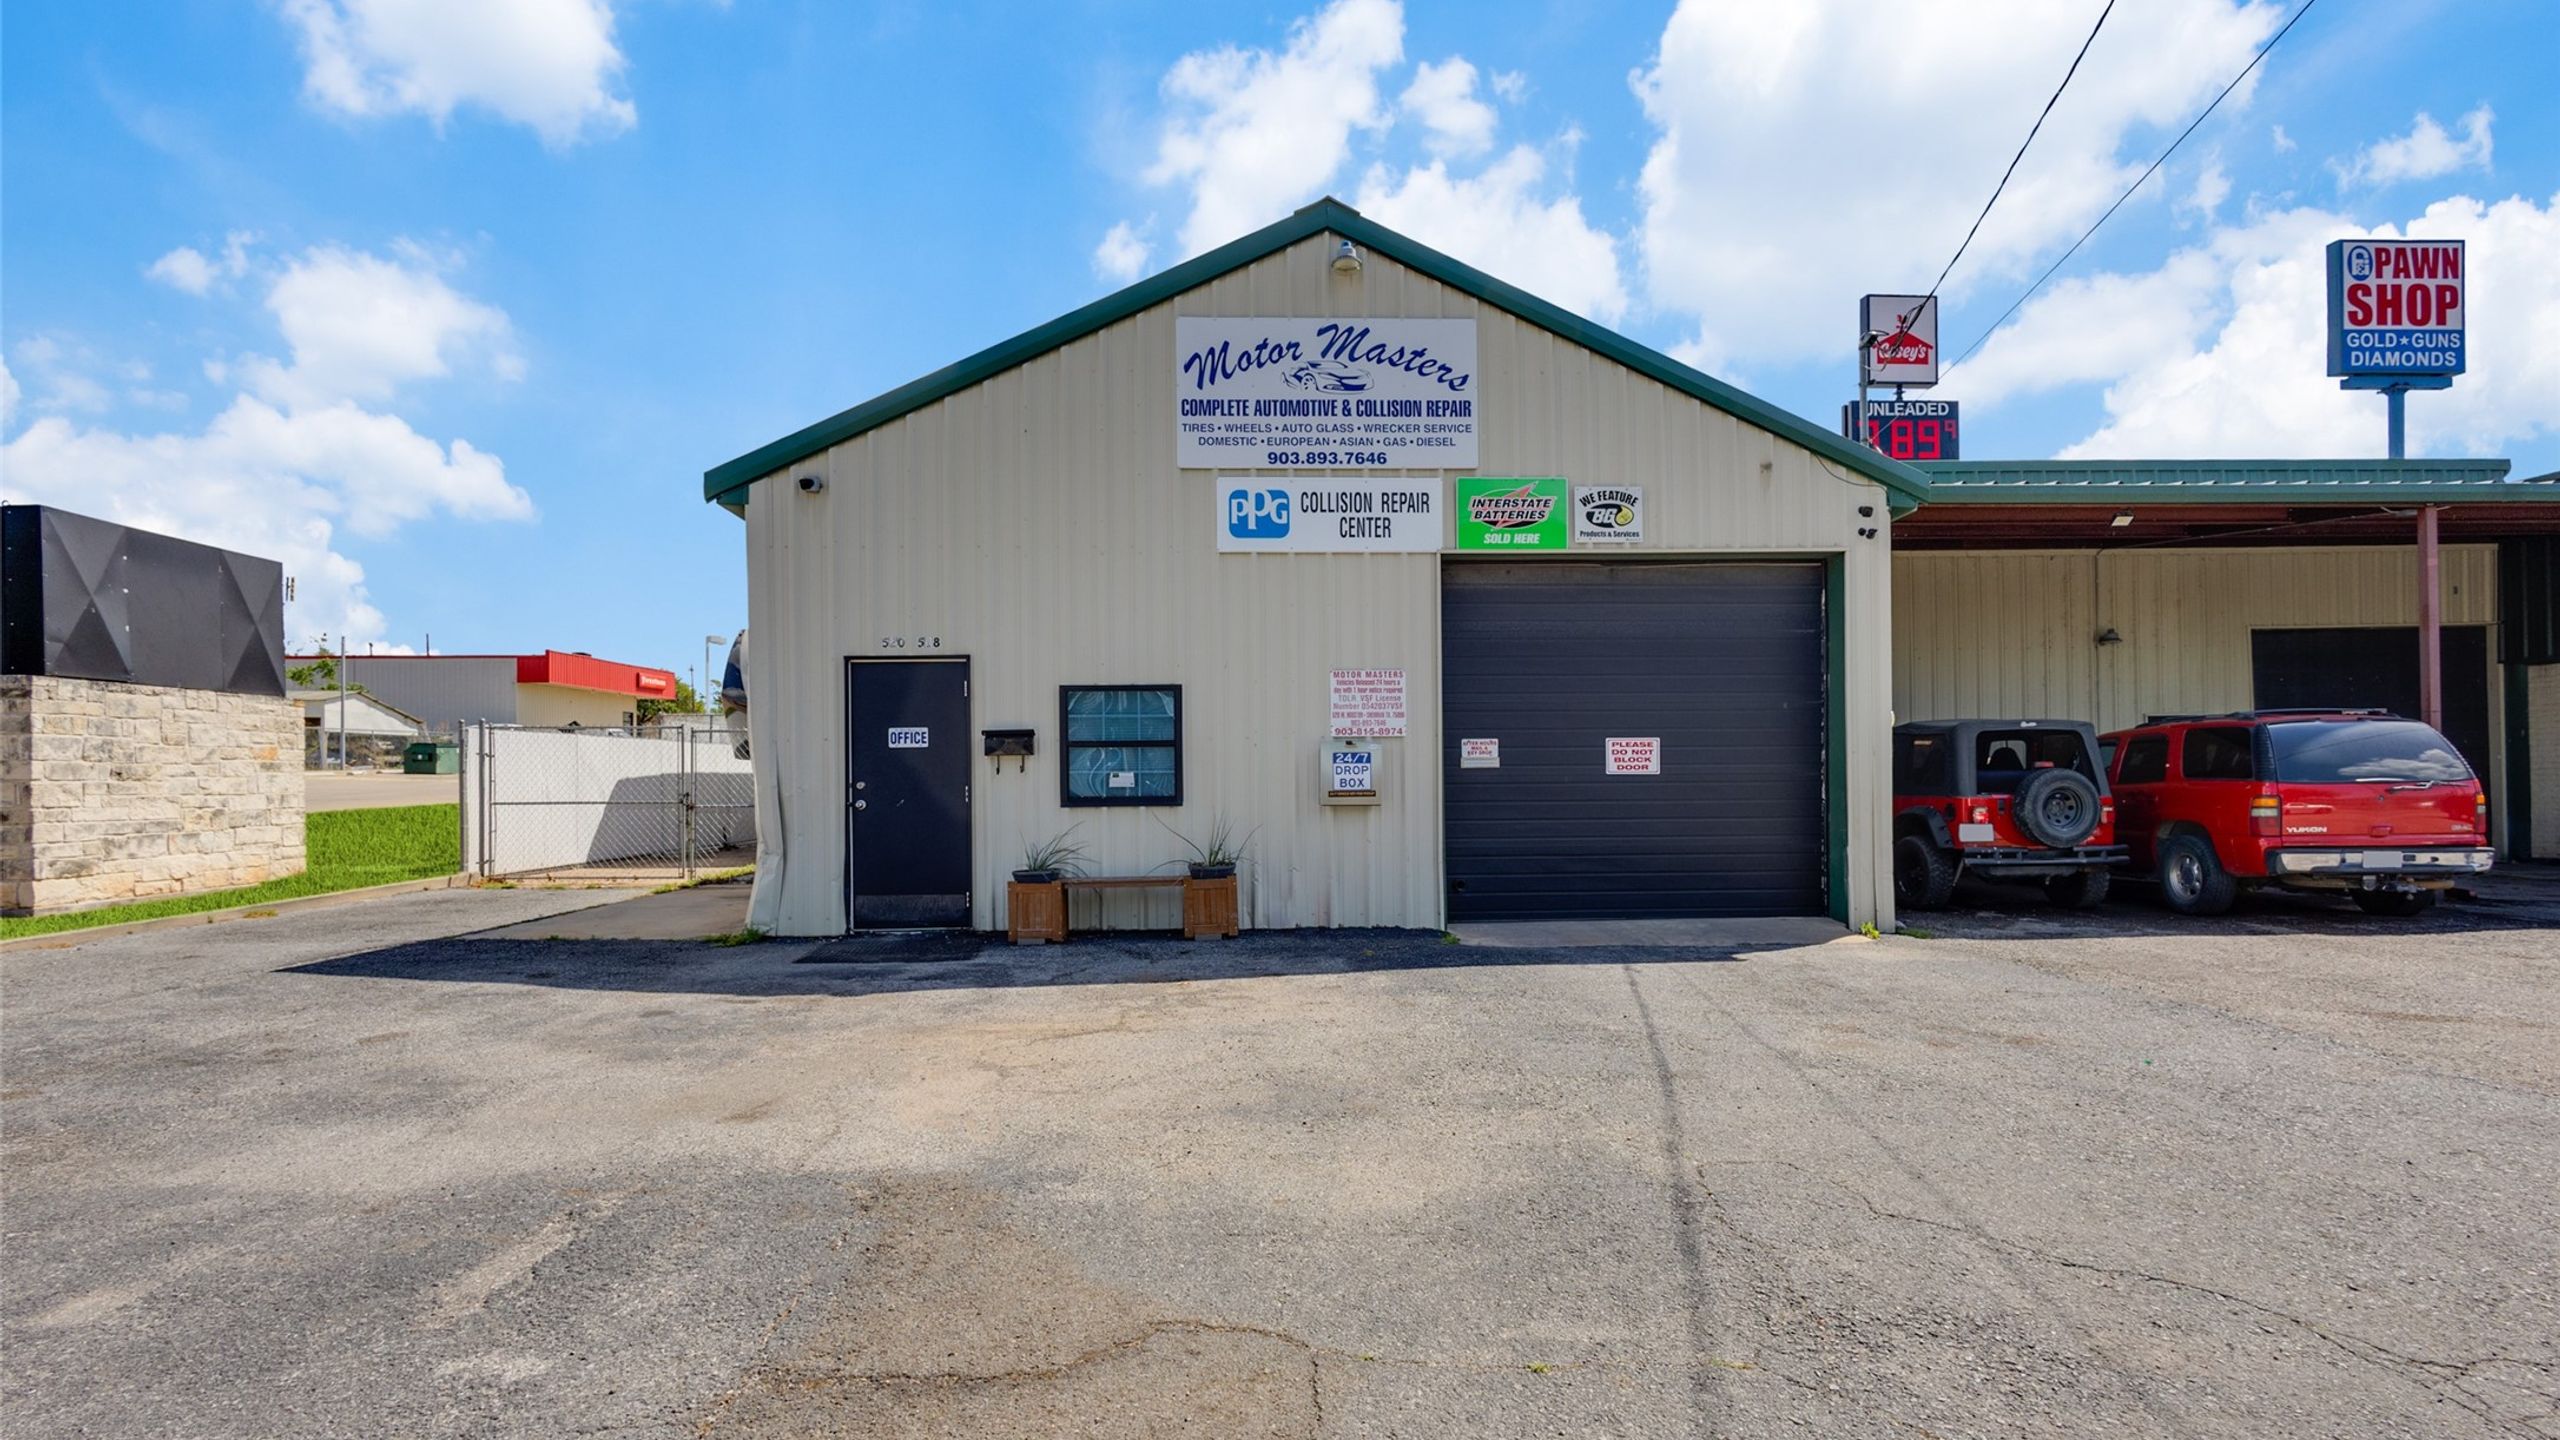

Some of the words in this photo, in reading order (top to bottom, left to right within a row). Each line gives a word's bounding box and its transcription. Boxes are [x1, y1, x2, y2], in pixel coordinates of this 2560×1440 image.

[2374, 247, 2459, 279] PAWN
[2347, 283, 2459, 327] SHOP
[2346, 332, 2397, 348] GOLD
[2411, 332, 2461, 348] GUNS
[1183, 338, 1303, 391] Motor
[1316, 323, 1470, 391] Masters
[2351, 351, 2457, 366] DIAMONDS
[1181, 399, 1249, 417] COMPLETE
[1254, 399, 1337, 417] AUTOMOTIVE
[1342, 399, 1352, 417] &
[1356, 399, 1422, 417] COLLISION
[1427, 399, 1472, 417] REPAIR
[1182, 423, 1215, 433] TIRES
[1224, 423, 1272, 433] WHEELS
[1281, 423, 1313, 433] AUTO
[1316, 423, 1354, 433] GLASS
[1363, 423, 1421, 433] WRECKER
[1423, 423, 1472, 433] SERVICE
[1198, 436, 1257, 447] DOMESTIC
[1266, 436, 1330, 447] EUROPEAN
[1339, 436, 1374, 447] ASIAN
[1383, 436, 1407, 447] GAS
[1416, 436, 1456, 447] DIESEL
[1268, 452, 1387, 465] 903.893.7646
[1301, 491, 1372, 513] COLLISION
[1381, 491, 1430, 513] REPAIR
[1471, 498, 1552, 508] INTERSTATE
[1579, 492, 1596, 507] WE
[1597, 490, 1639, 507] FEATURE
[1474, 510, 1546, 519] BATTERIES
[1592, 508, 1618, 524] BG
[1339, 516, 1391, 538] CENTER
[1483, 533, 1512, 544] SOLD
[1513, 533, 1541, 544] HERE
[1580, 530, 1607, 538] Products
[1613, 530, 1640, 538] Services
[917, 637, 940, 648] 58
[890, 731, 927, 744] OFFICE
[1334, 727, 1403, 735] 903-815-8974
[1335, 753, 1369, 763] 24/7
[1335, 766, 1369, 775] DROP
[1339, 778, 1365, 788] BOX
